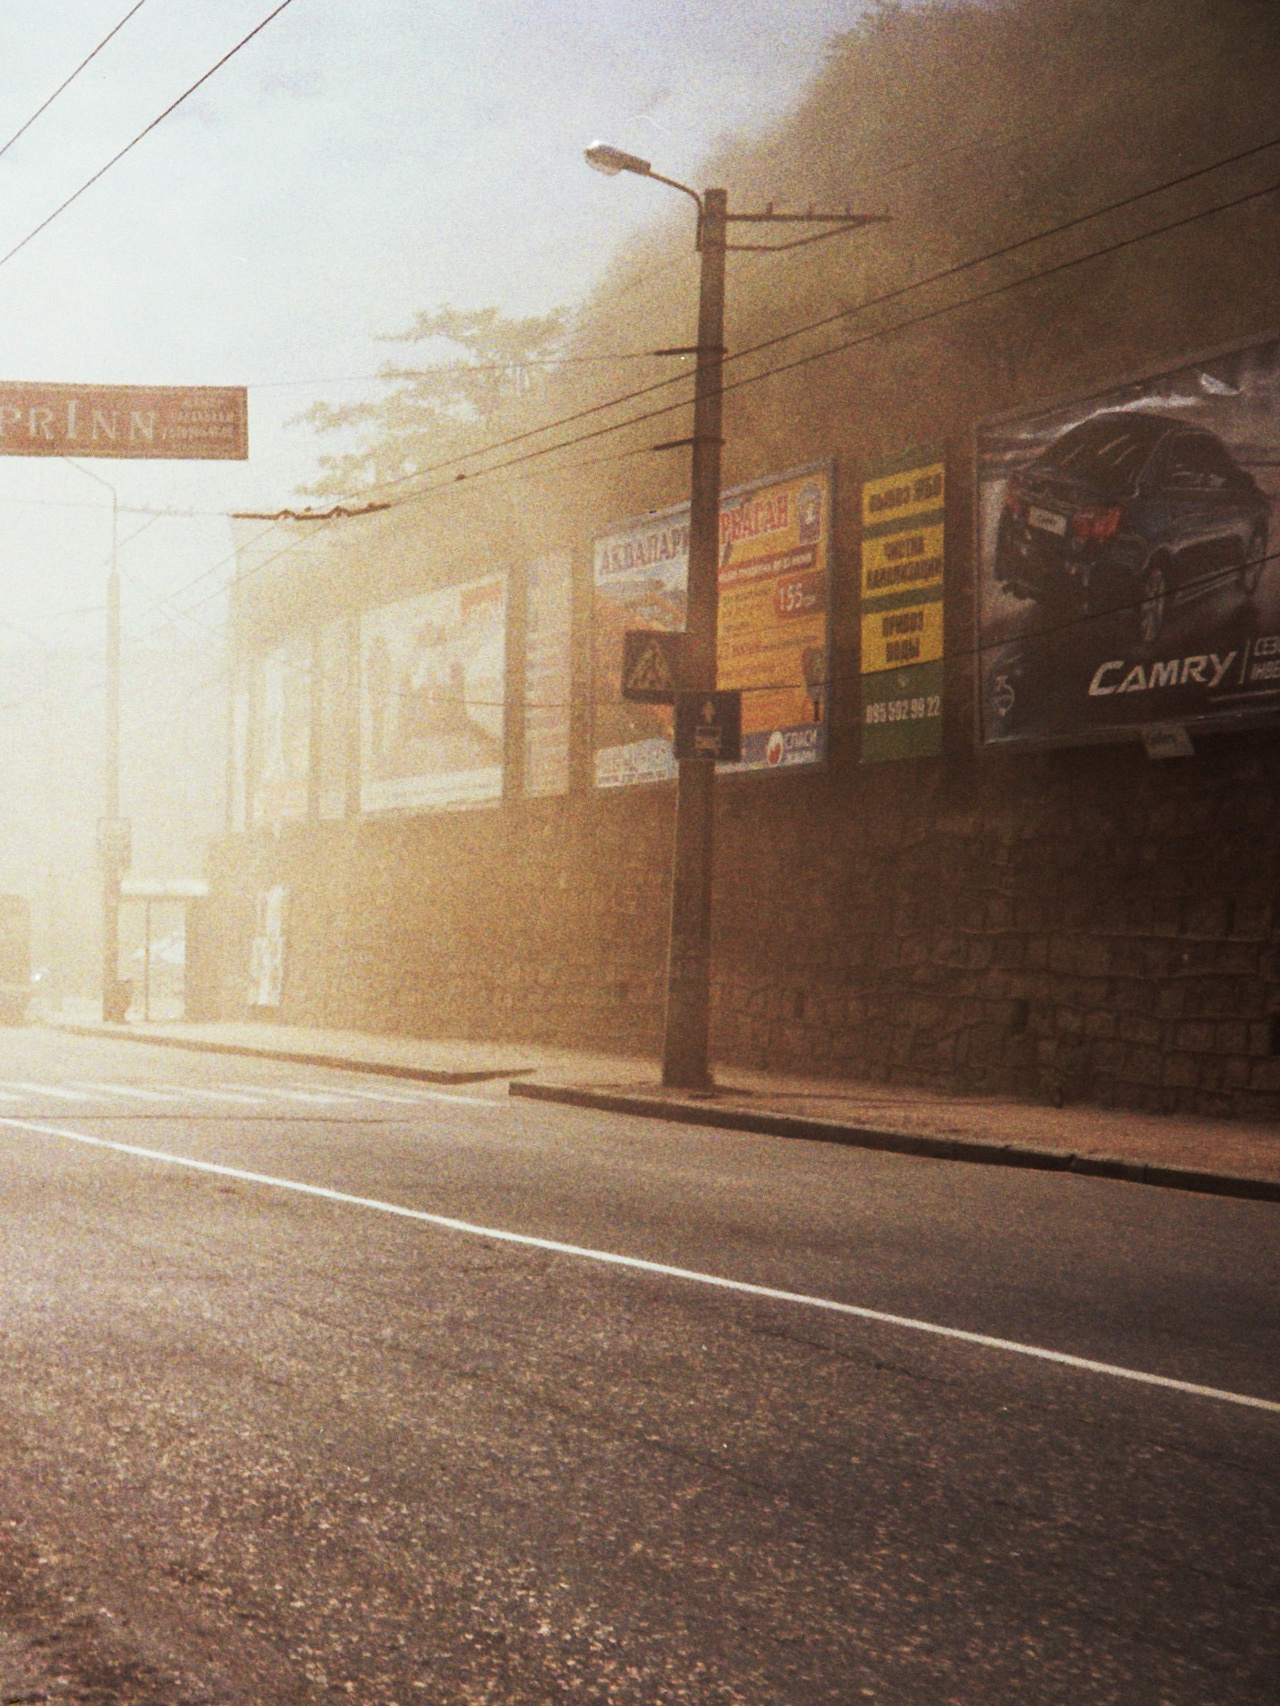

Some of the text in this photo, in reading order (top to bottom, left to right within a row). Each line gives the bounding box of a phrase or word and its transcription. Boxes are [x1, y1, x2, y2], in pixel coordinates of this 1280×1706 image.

[778, 581, 804, 612] 155
[1088, 651, 1238, 697] CAMRY
[927, 695, 942, 718] 22
